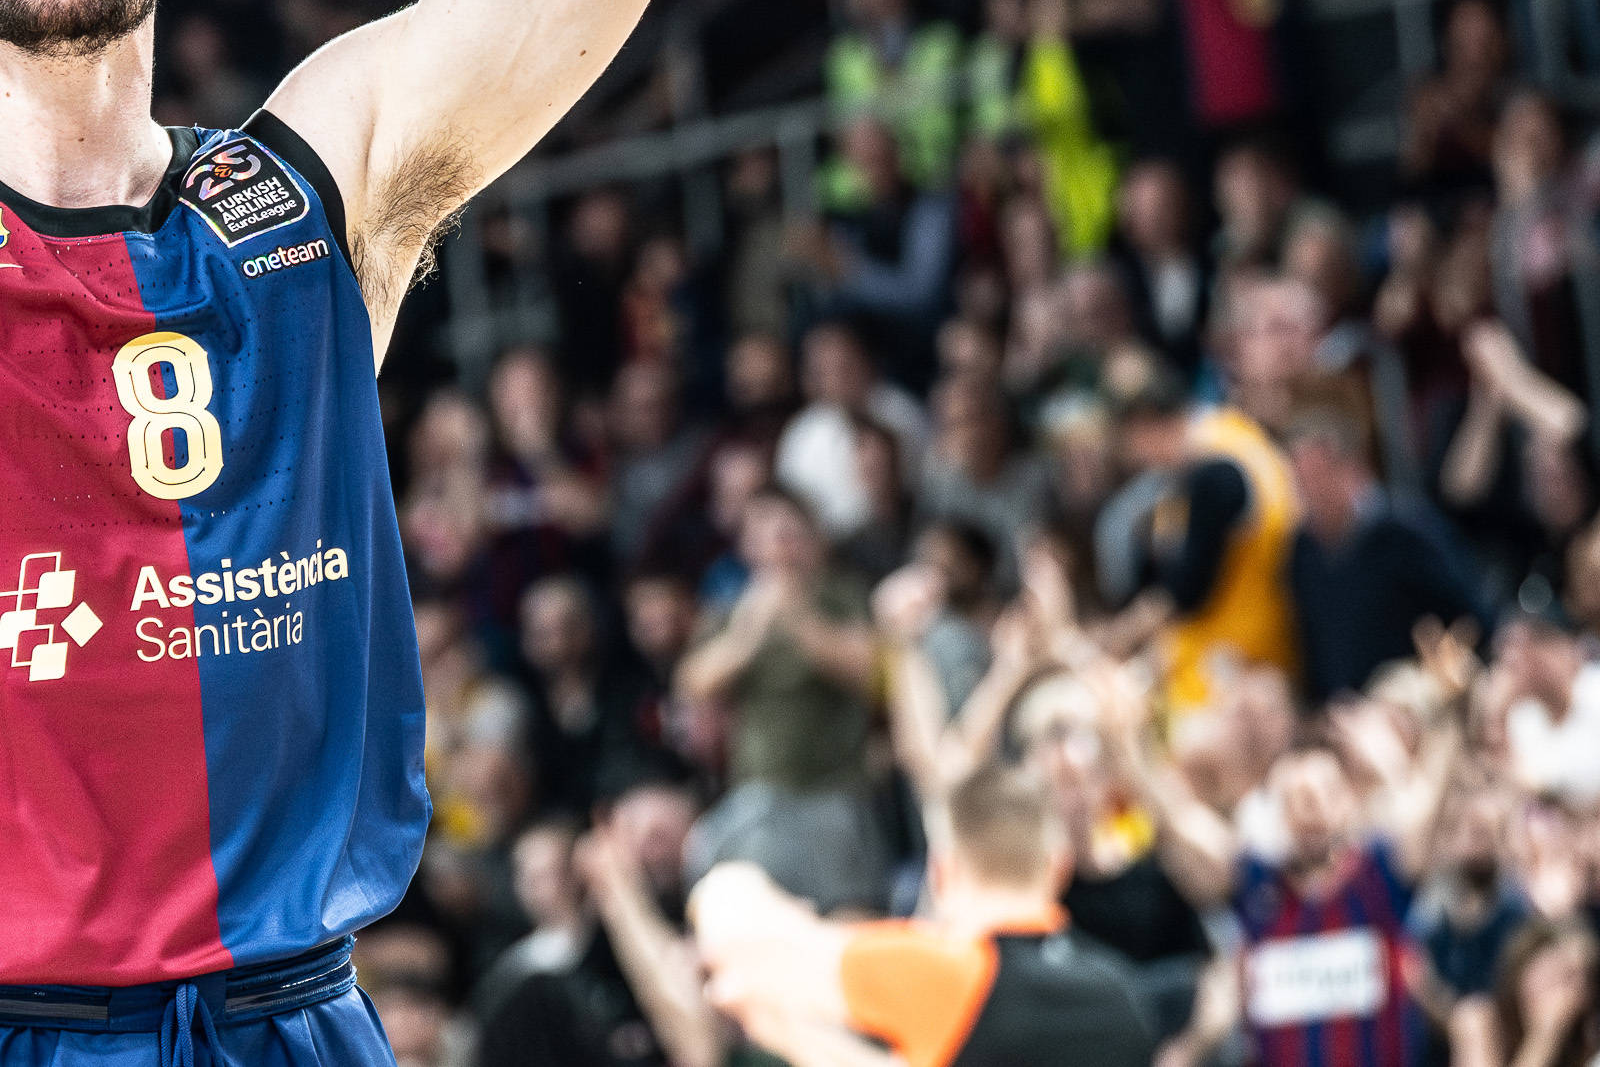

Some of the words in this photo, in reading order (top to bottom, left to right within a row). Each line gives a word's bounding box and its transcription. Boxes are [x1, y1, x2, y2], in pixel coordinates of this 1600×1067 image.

[212, 176, 282, 213] TURKISH
[222, 187, 290, 225] AIRLINES
[227, 199, 297, 232] EuroLeague
[243, 239, 329, 277] oneteam
[111, 331, 224, 500] 8
[130, 539, 349, 612] Assistència
[135, 602, 304, 662] Sanitària
